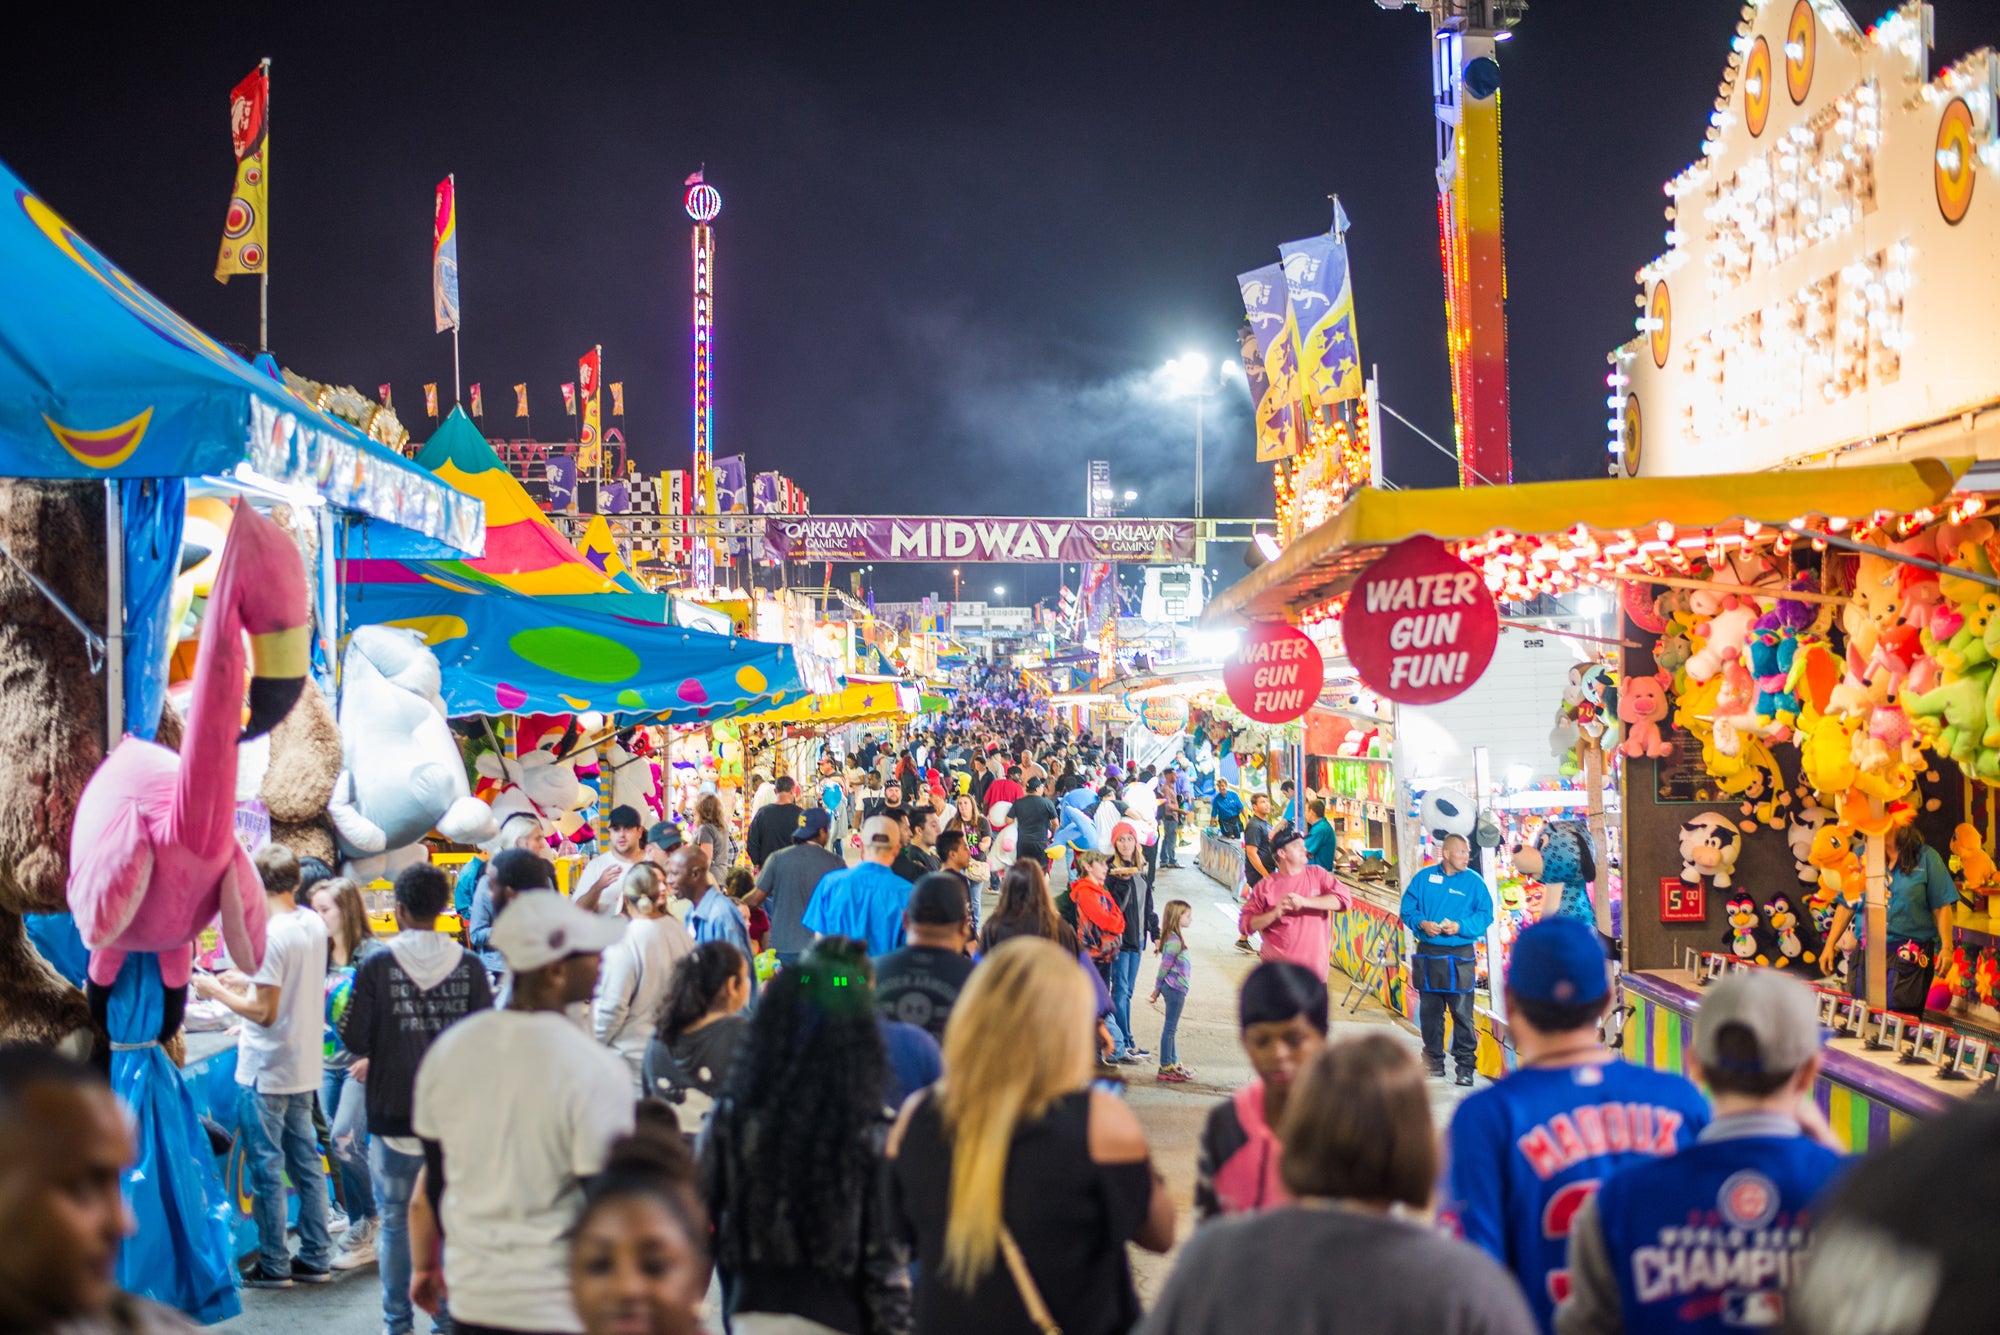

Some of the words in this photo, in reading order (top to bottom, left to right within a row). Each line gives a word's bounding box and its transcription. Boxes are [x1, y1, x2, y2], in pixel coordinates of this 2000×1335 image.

[672, 477, 681, 546] FRIES
[785, 521, 867, 538] OAKLAWN
[890, 521, 1070, 558] MIDWAY
[1091, 525, 1174, 541] OAKLAWN
[805, 538, 848, 549] GAMING
[1112, 541, 1154, 551] GAMING
[1365, 570, 1479, 614] WATER
[982, 630, 1014, 638] MIDWAY
[1390, 611, 1461, 651] GUN
[1237, 638, 1308, 665] WATER
[1253, 664, 1299, 689] GUN
[1389, 651, 1469, 690] FUN!
[1253, 689, 1304, 713] FUN!
[1143, 707, 1183, 721] GUN
[1670, 890, 1682, 910] 5
[428, 998, 468, 1014] SPACE
[1517, 1101, 1683, 1181] MADDUX
